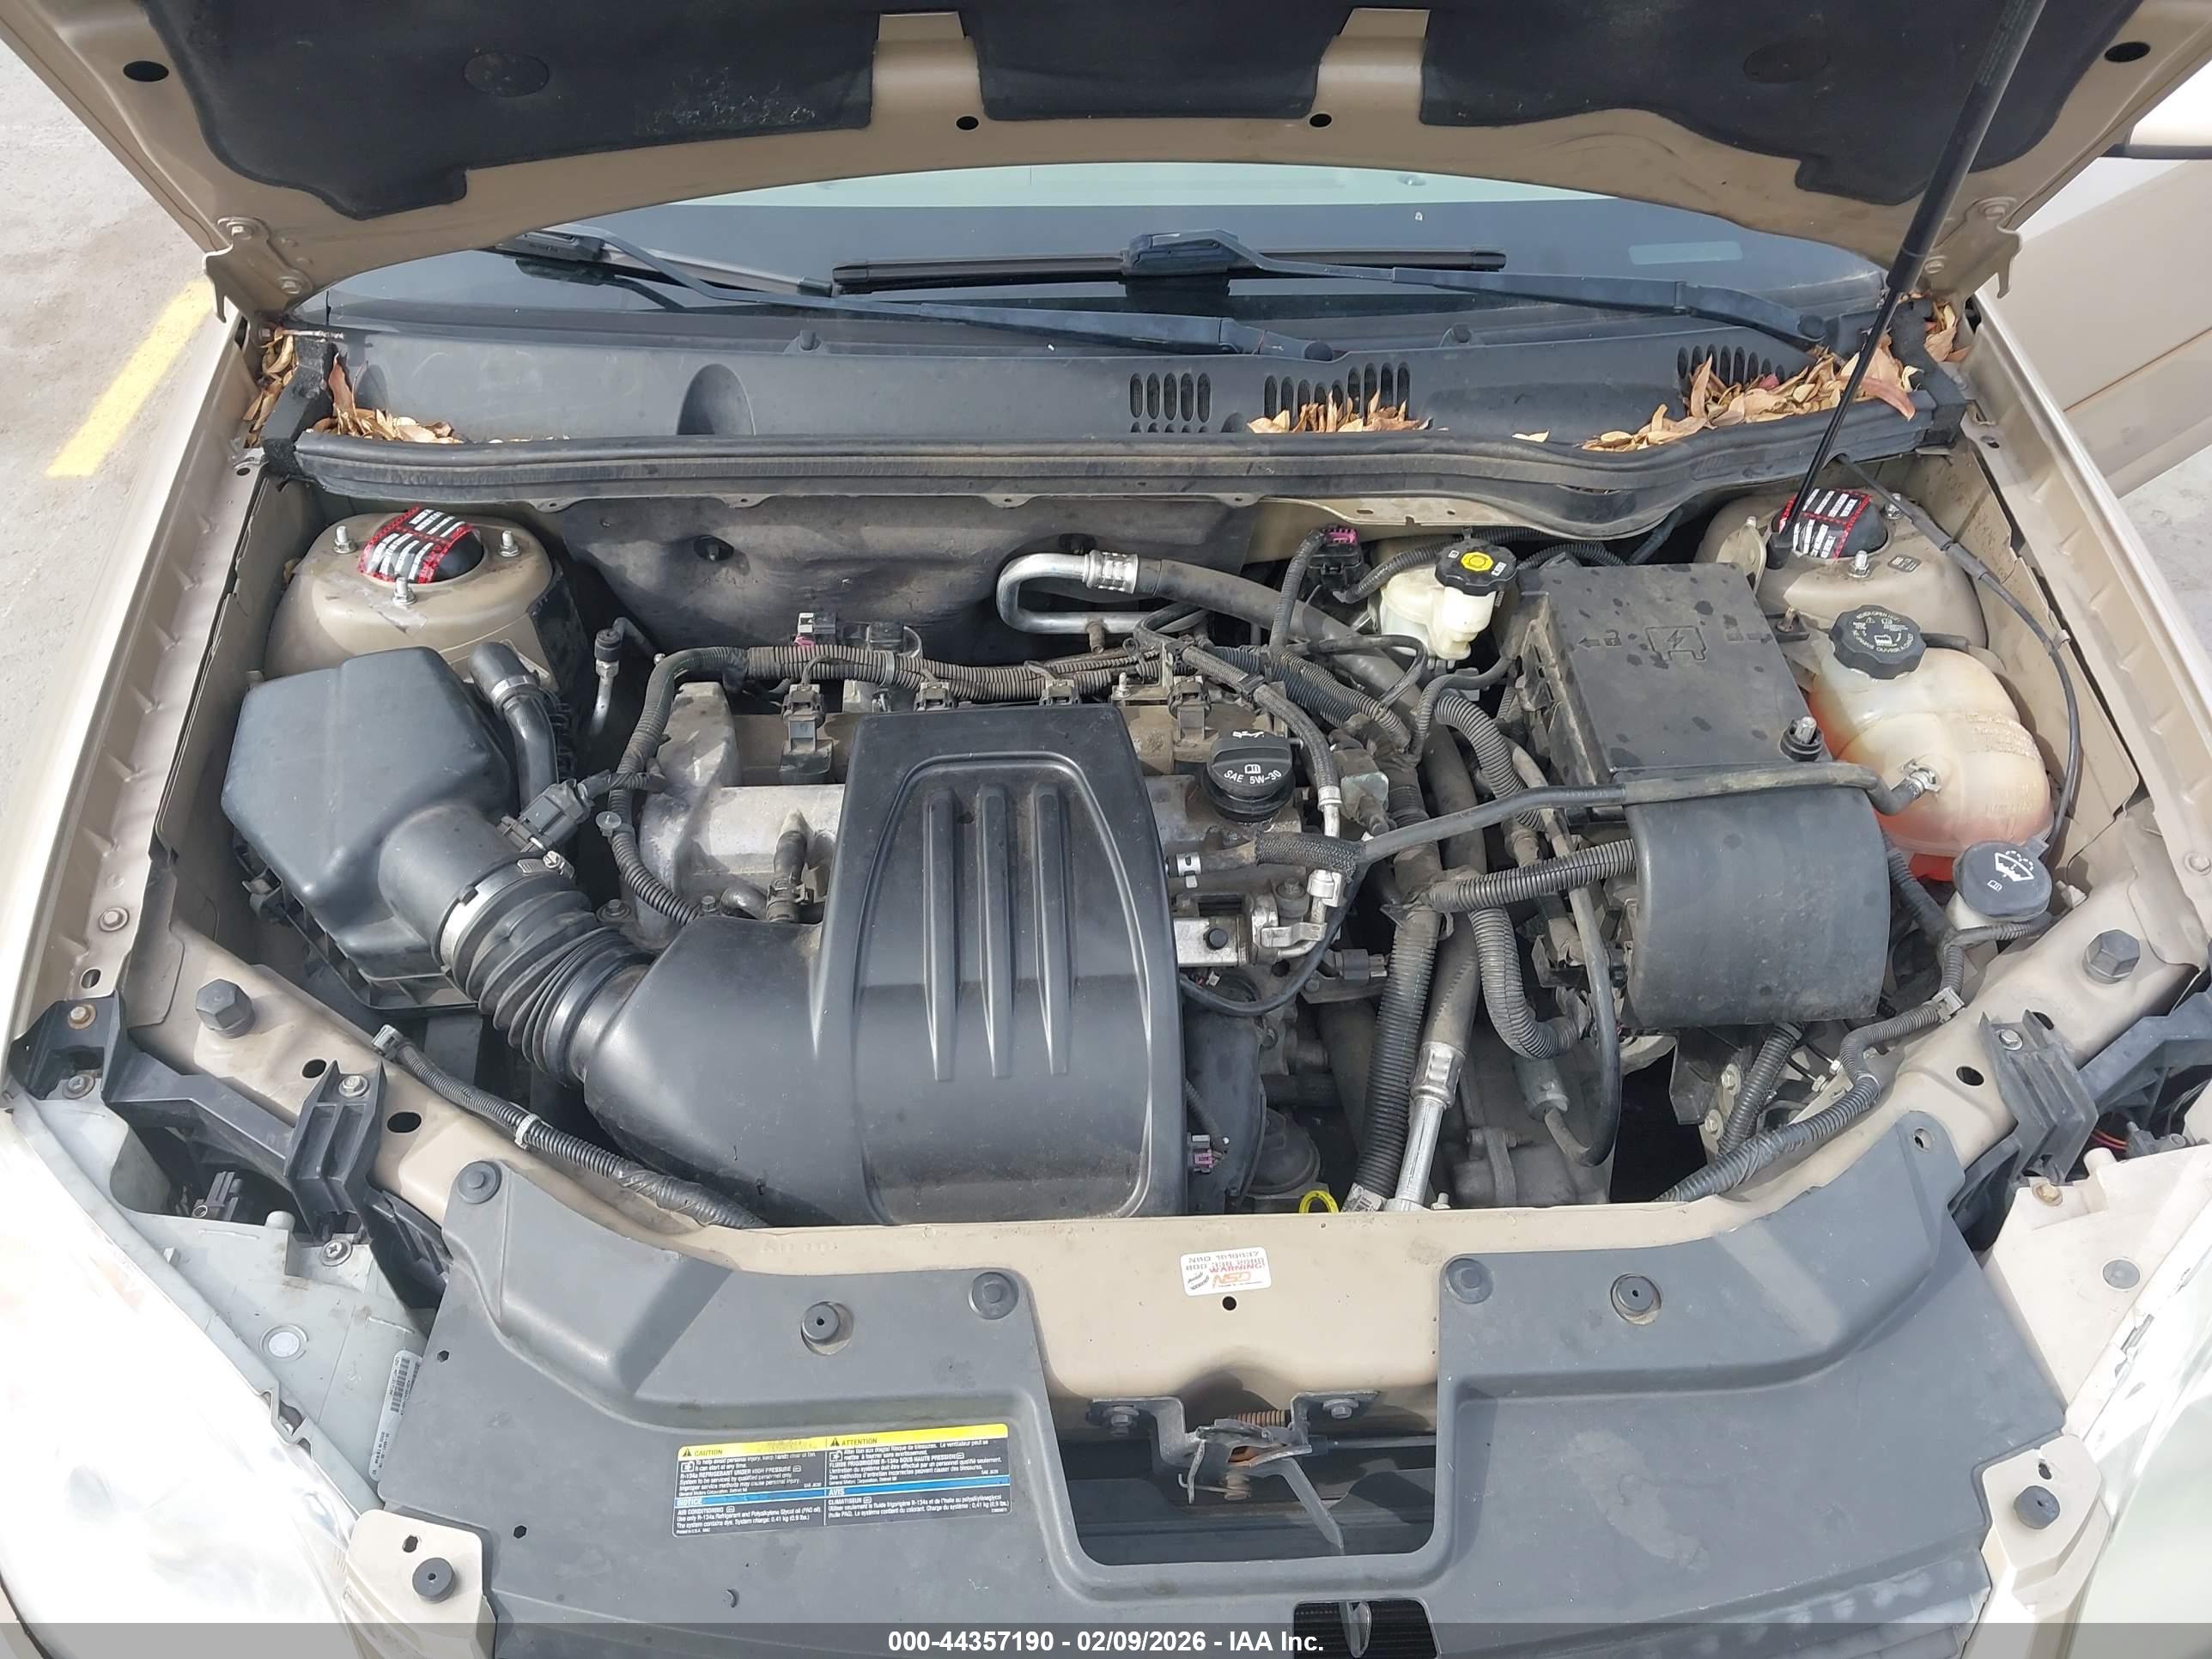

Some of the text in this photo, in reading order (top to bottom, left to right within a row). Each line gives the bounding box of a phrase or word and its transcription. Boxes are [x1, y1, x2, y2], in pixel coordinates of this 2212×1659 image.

[1224, 769, 1282, 785] SAE 5W-30
[829, 1488, 845, 1497] AVIS
[677, 1498, 702, 1507] NOTICE
